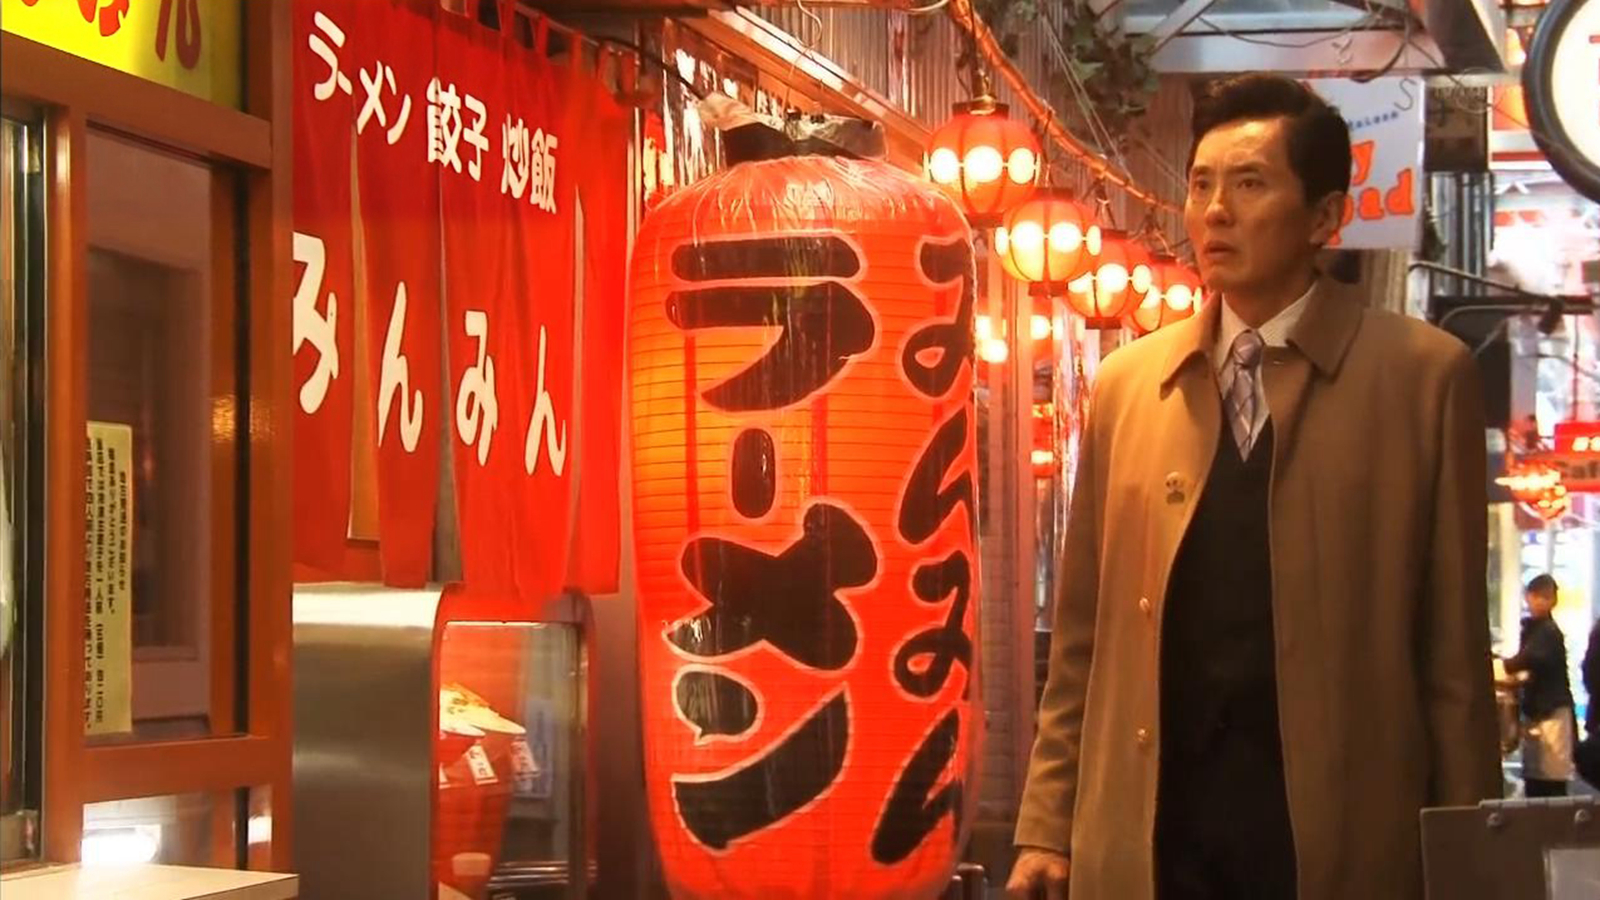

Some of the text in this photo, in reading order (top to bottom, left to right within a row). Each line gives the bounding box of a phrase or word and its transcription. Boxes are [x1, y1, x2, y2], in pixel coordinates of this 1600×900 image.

[308, 11, 412, 145] ラーメン
[426, 76, 490, 182] 餃子
[500, 112, 558, 215] 炒飯
[292, 231, 567, 477] みんみん
[664, 233, 876, 852] ラーメン
